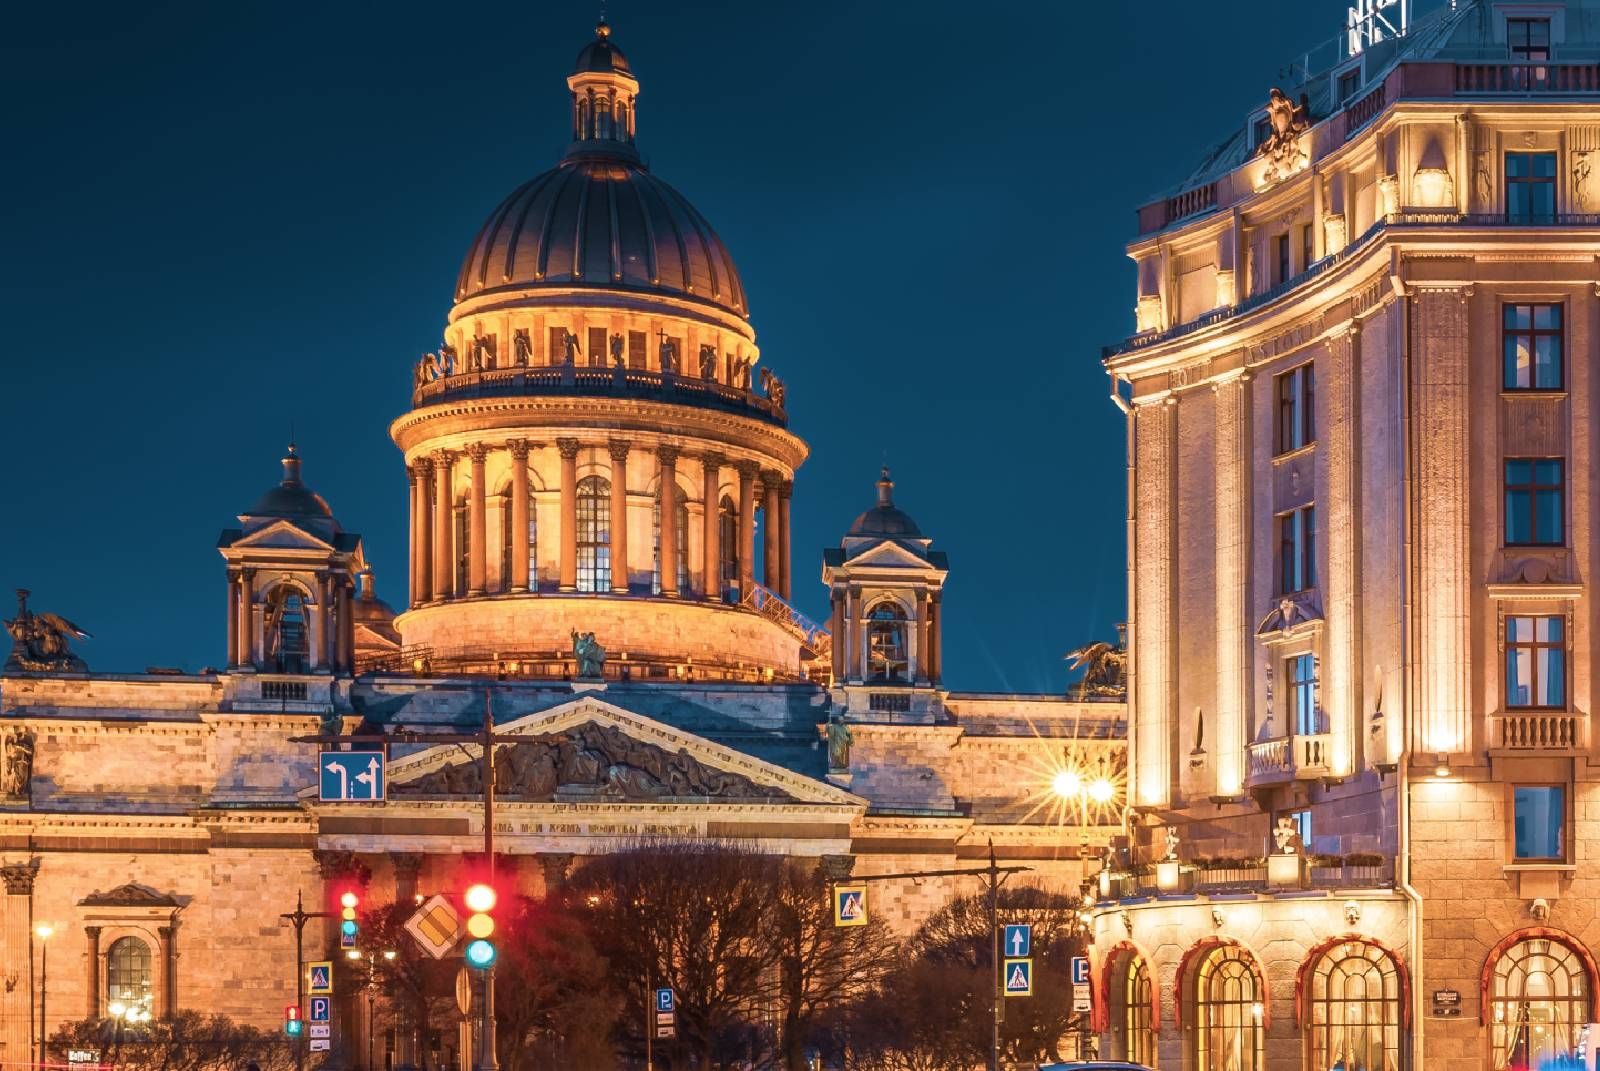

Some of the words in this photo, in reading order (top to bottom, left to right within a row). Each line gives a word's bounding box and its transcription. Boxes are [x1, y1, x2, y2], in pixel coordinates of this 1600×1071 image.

[1078, 959, 1088, 981] P
[314, 999, 326, 1019] P
[661, 991, 671, 1009] P
